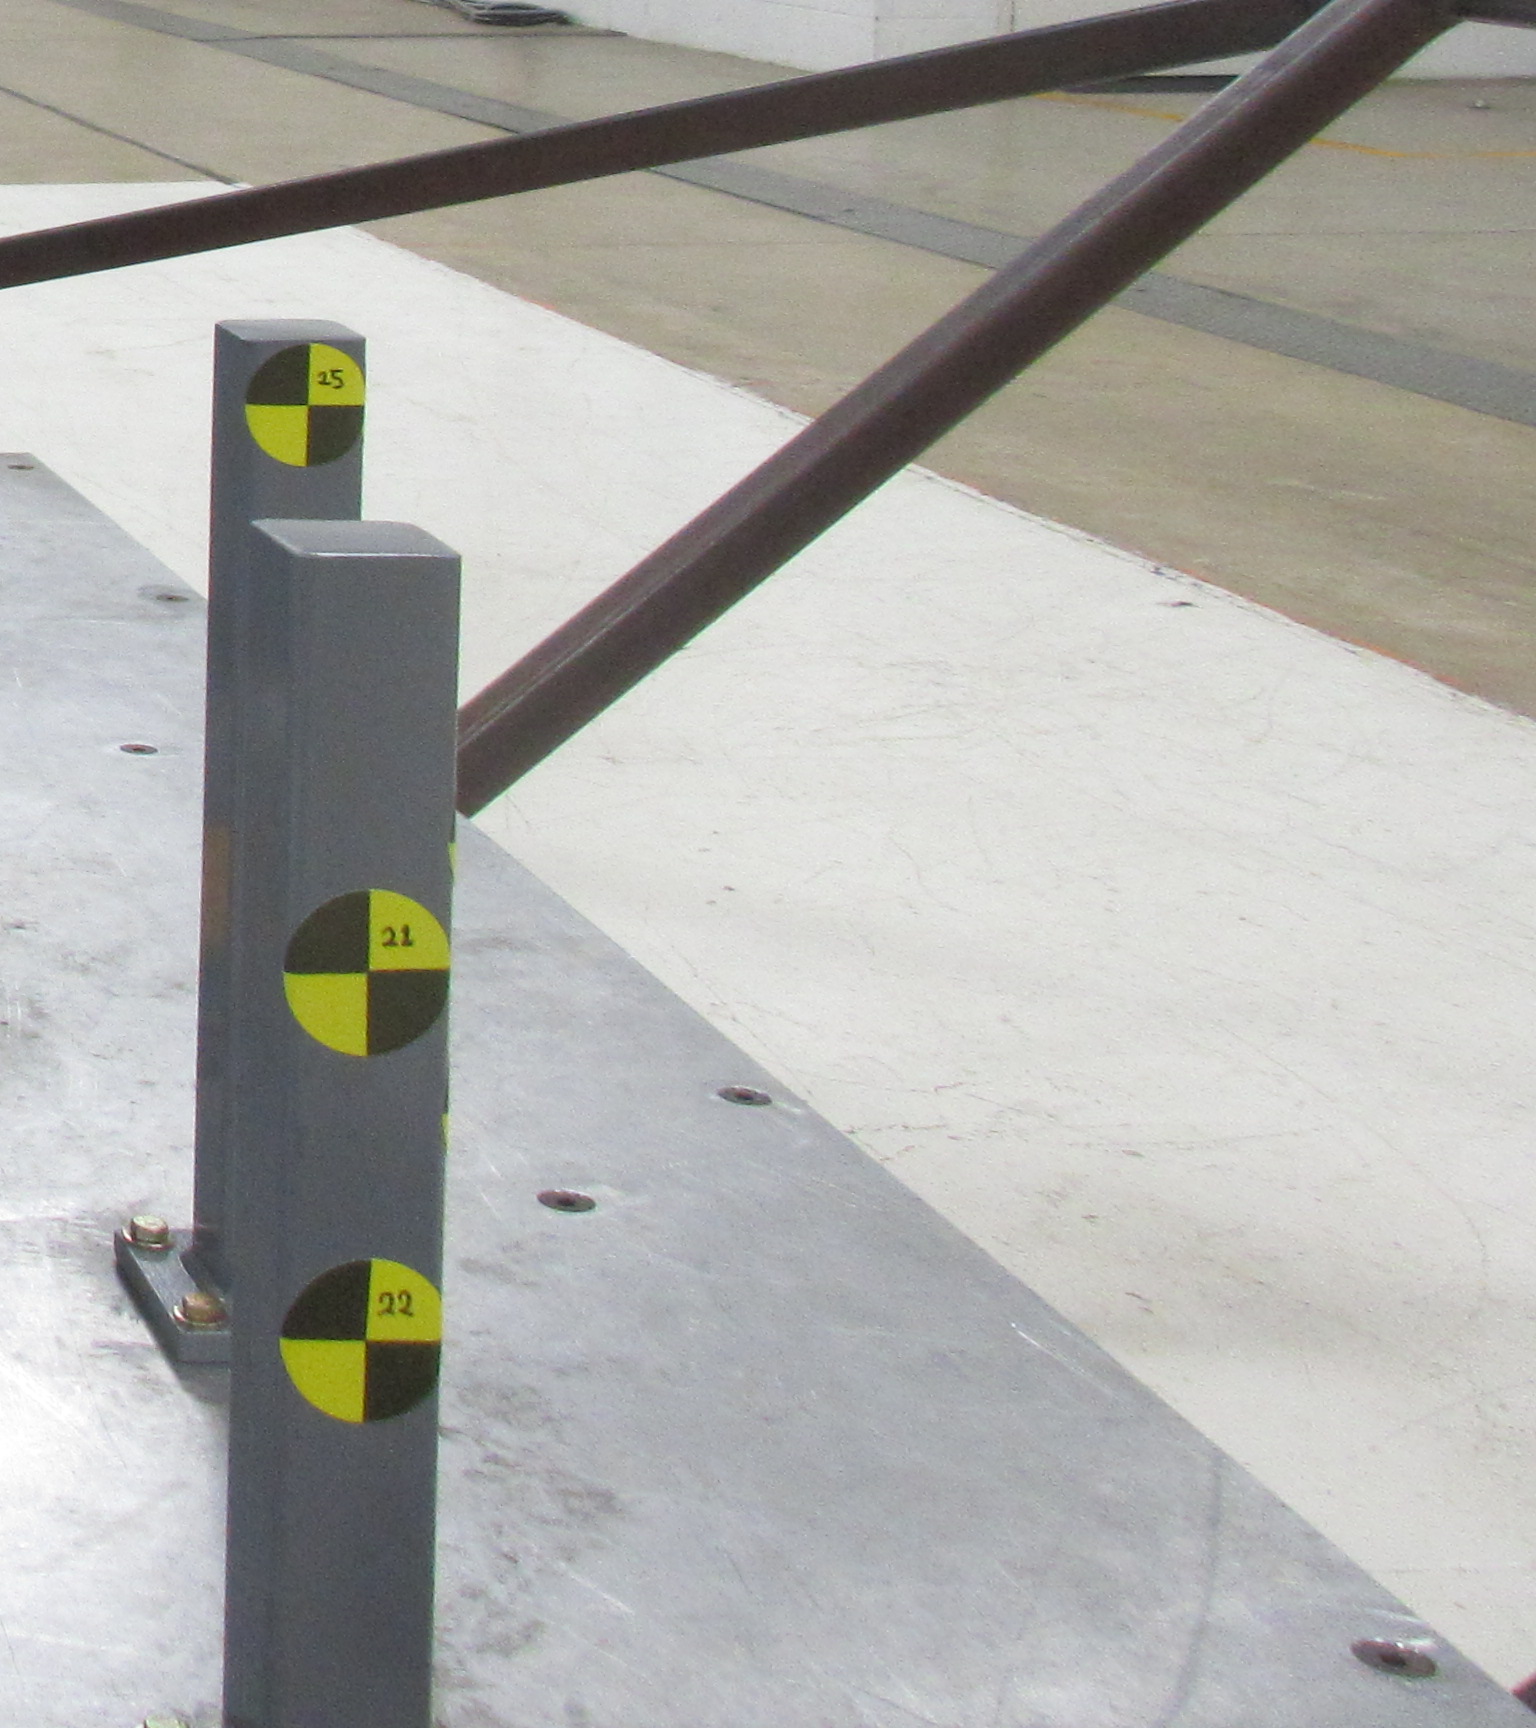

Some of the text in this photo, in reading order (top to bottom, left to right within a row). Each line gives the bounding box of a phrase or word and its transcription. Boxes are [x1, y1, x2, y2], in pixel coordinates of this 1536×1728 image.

[316, 369, 345, 389] 15
[381, 924, 415, 947] 21
[378, 1289, 414, 1318] 22
